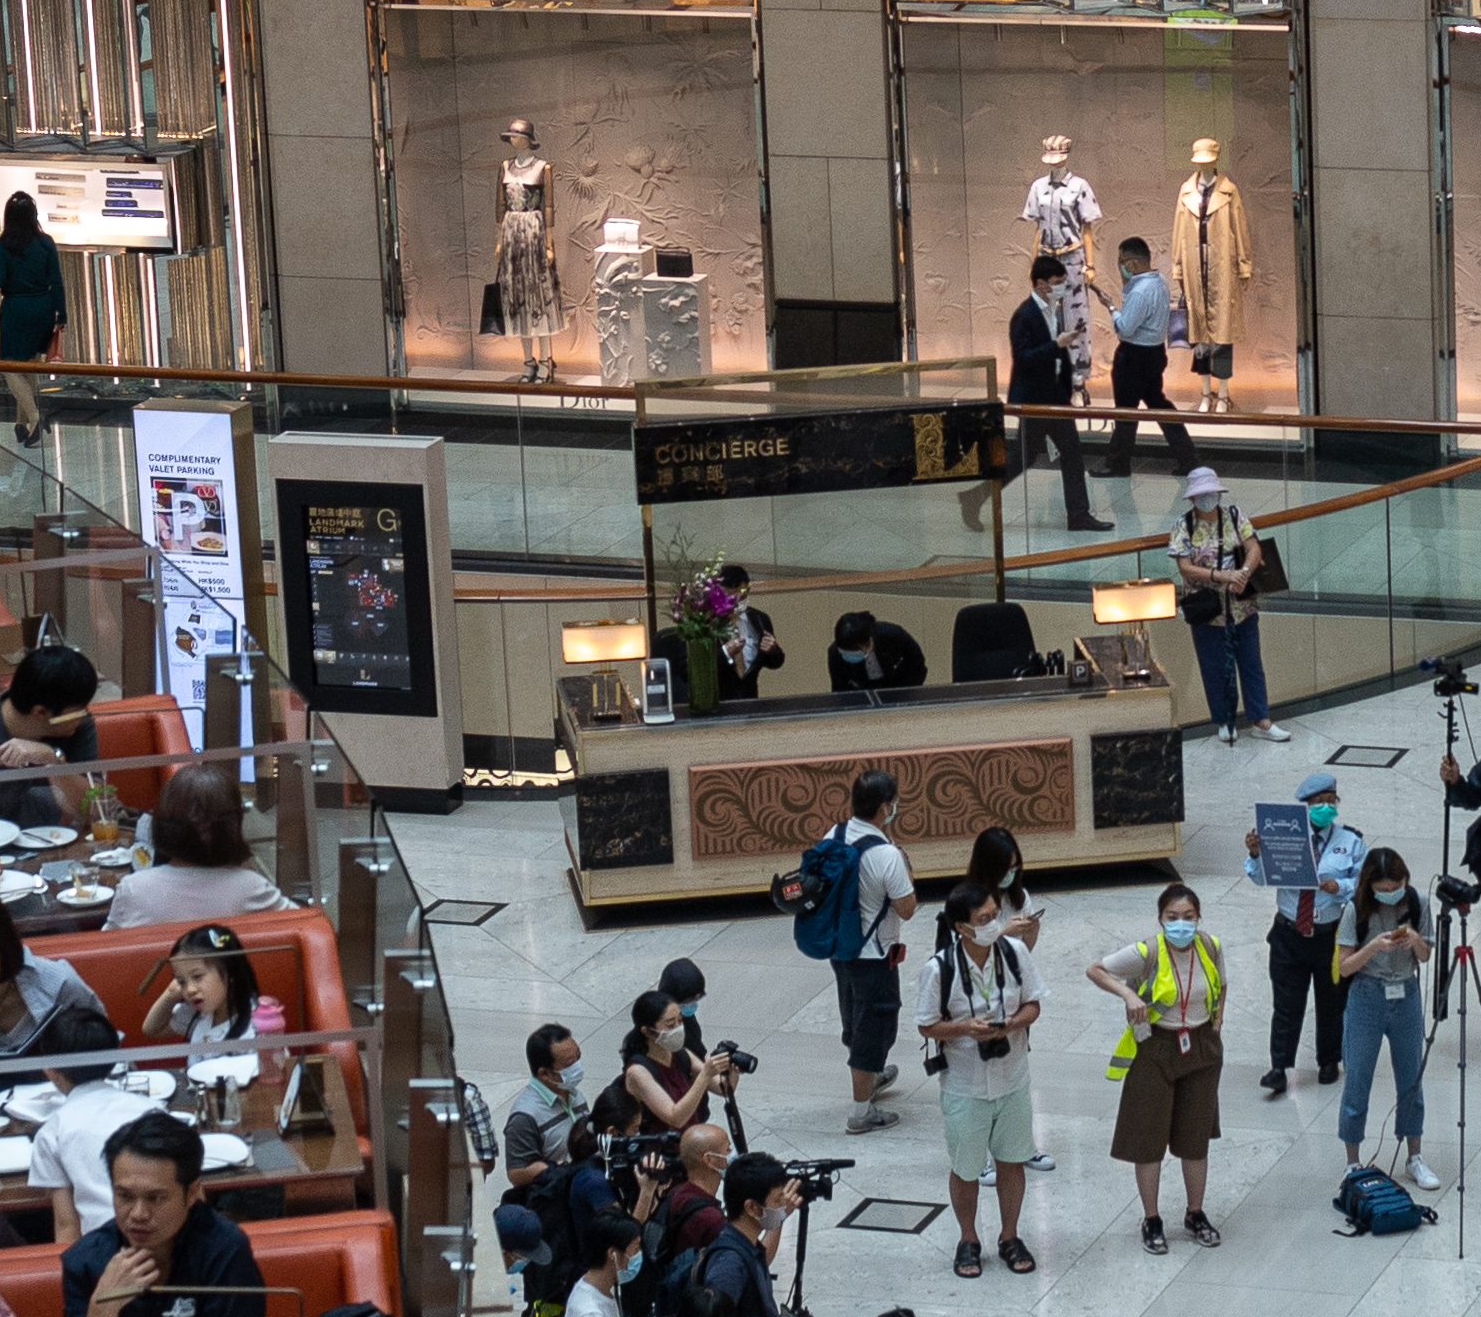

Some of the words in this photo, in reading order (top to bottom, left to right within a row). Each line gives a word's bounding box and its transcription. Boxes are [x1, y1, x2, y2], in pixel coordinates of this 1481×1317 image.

[655, 438, 790, 465] CONCIERGE
[147, 453, 222, 466] COMPLIMENTARY
[148, 464, 175, 474] VALET
[176, 465, 216, 476] PARKING
[170, 490, 207, 541] P
[377, 508, 397, 532] G
[308, 517, 365, 529] LANDMARK
[310, 526, 346, 535] ATRIUM
